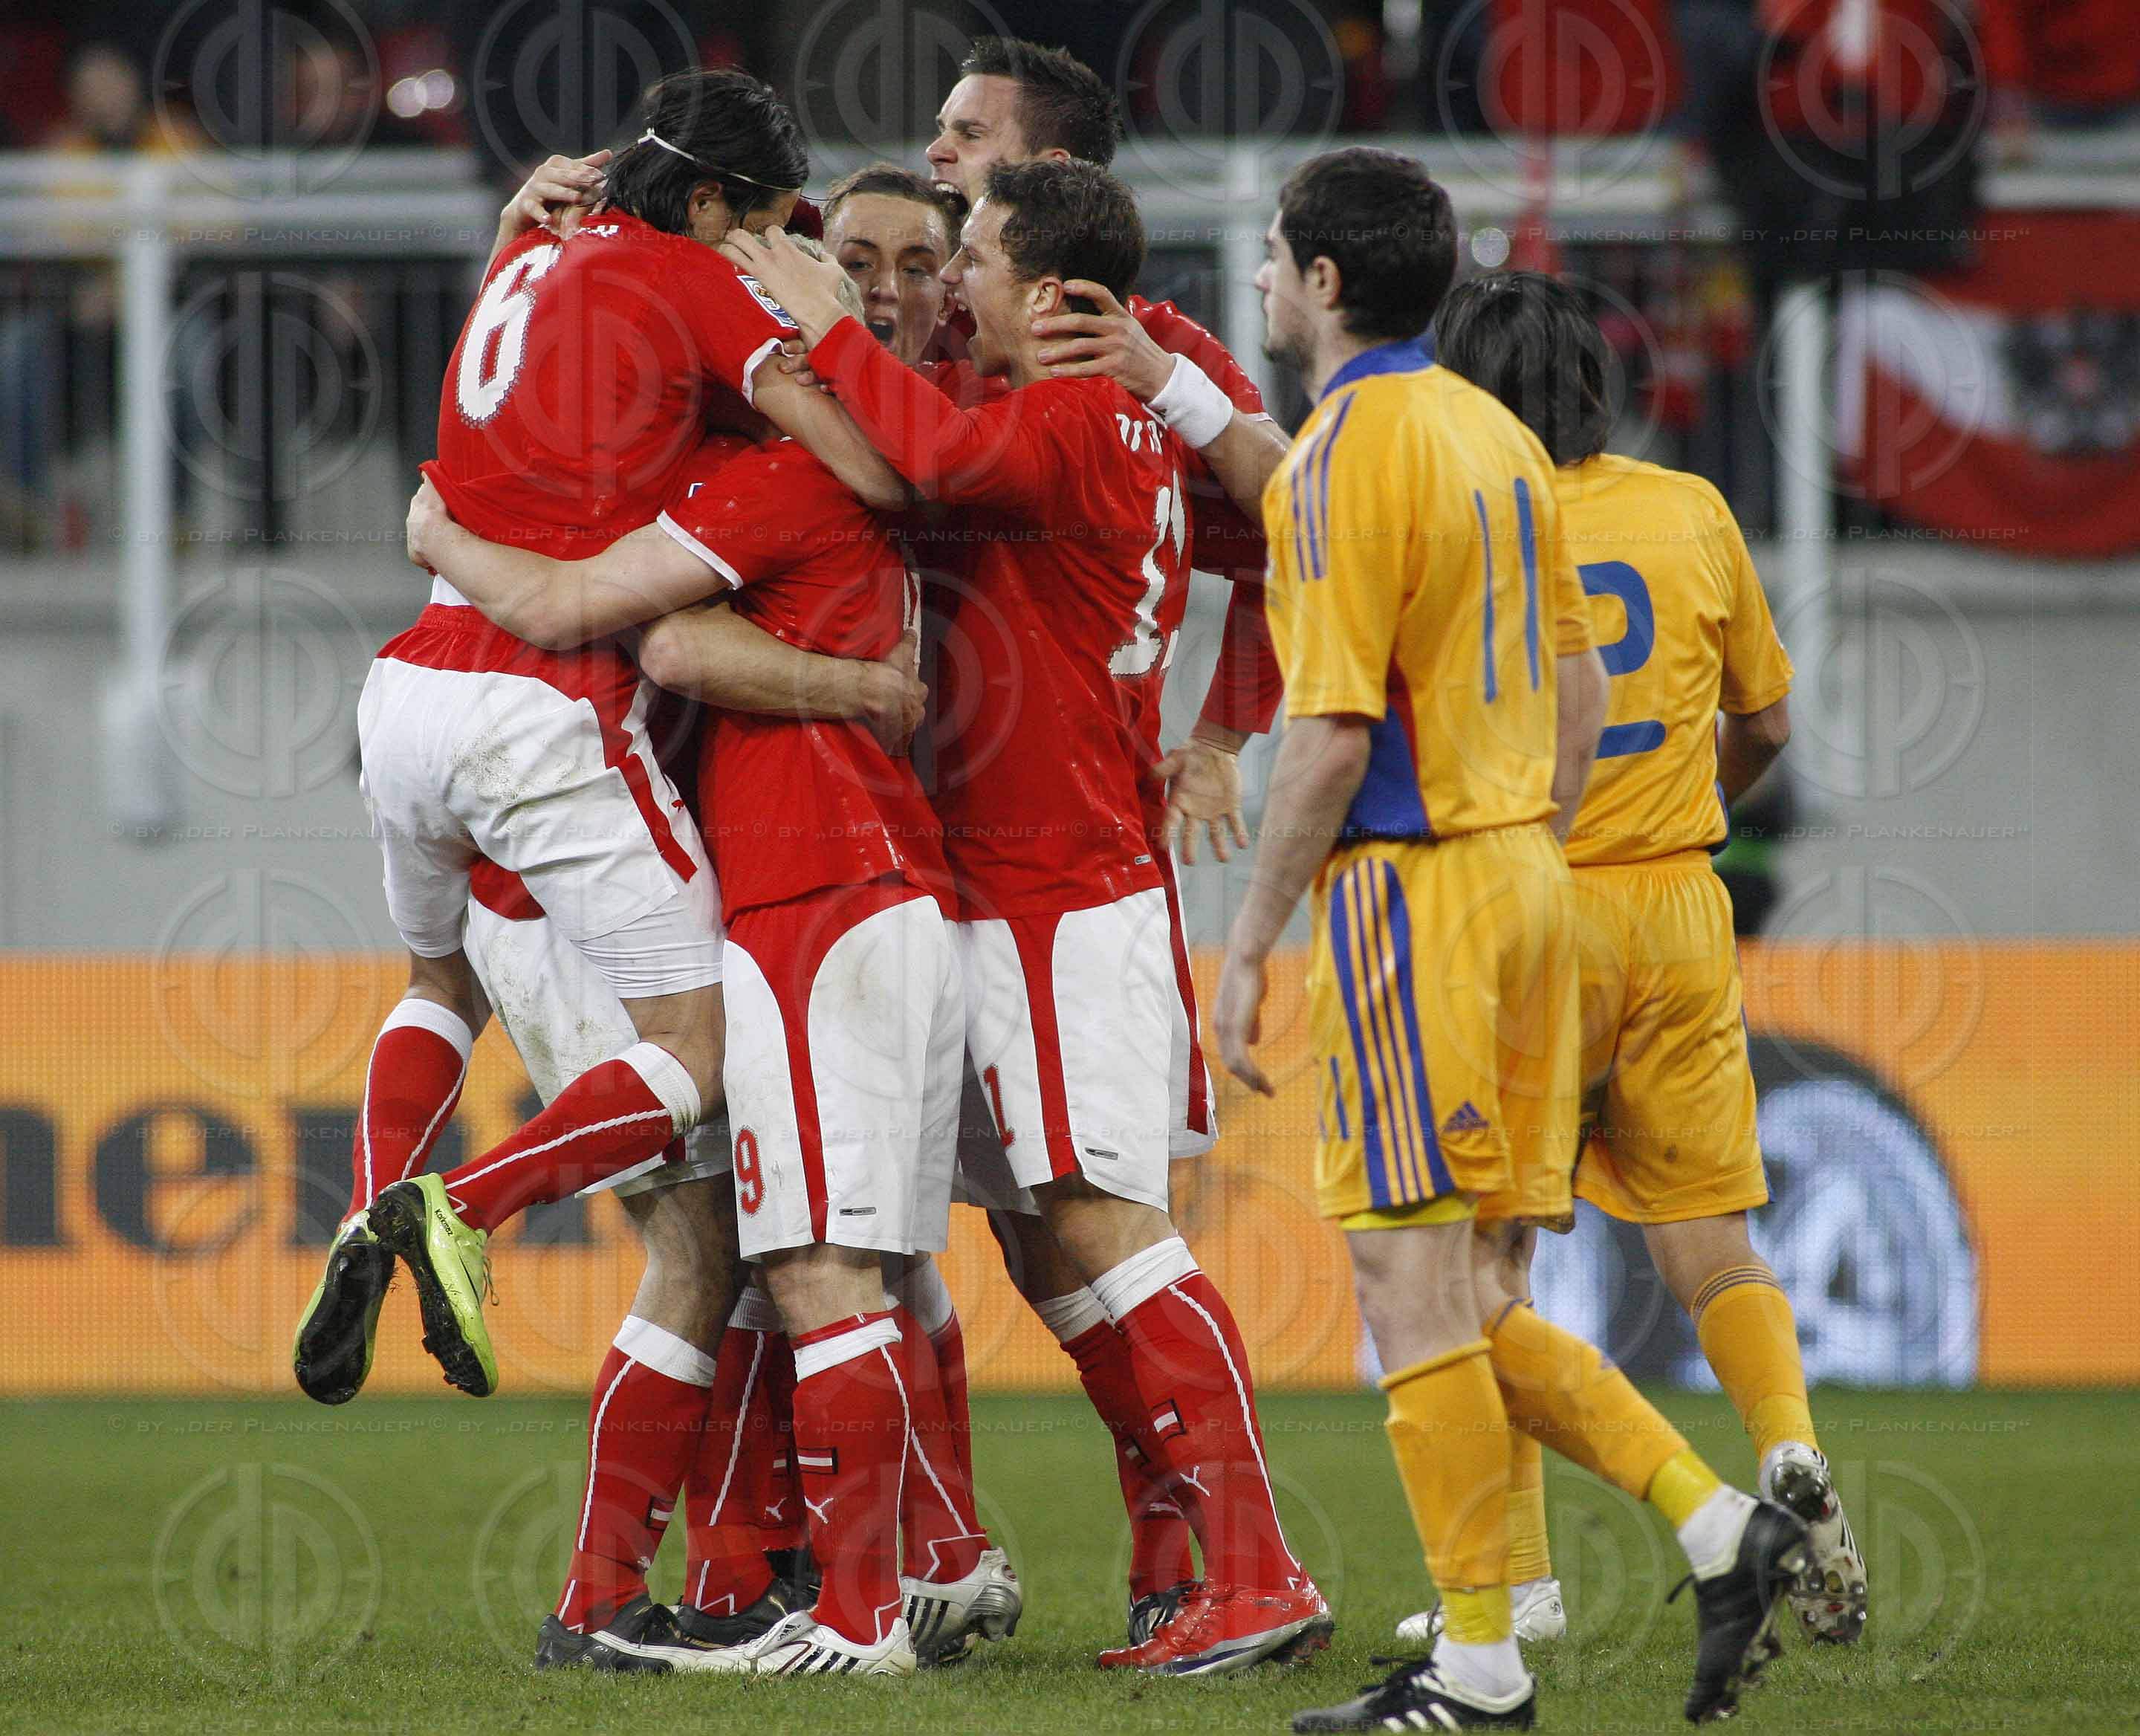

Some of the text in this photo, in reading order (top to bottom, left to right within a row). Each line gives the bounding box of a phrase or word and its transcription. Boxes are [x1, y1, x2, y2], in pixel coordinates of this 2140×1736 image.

[455, 243, 565, 430] 6
[1473, 476, 1540, 705] 11
[731, 1124, 768, 1217] 9
